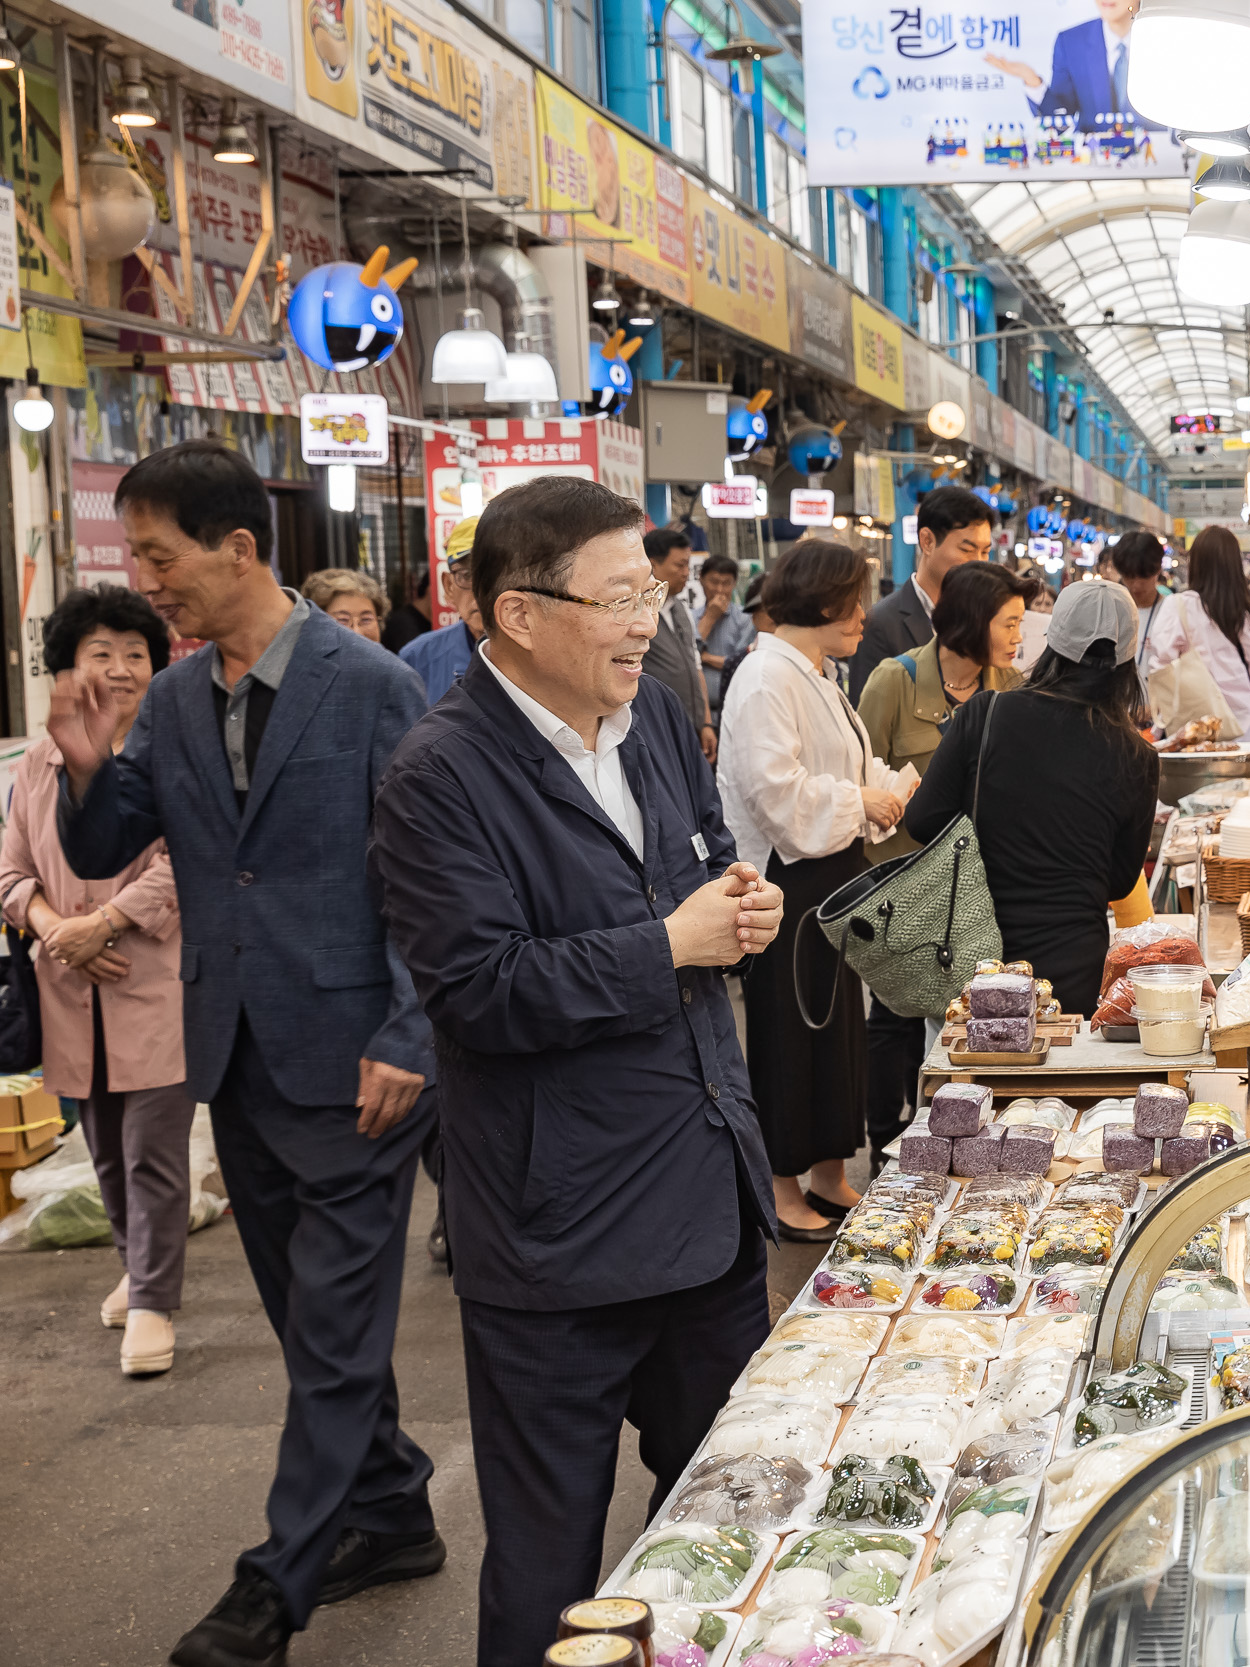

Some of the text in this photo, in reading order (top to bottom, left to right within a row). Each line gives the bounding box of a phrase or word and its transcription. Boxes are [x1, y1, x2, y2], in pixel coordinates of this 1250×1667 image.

[832, 8, 1020, 59] 당신 곁에 함께
[897, 75, 1005, 92] MG 새마을금고
[511, 443, 581, 462] 추천조합!
